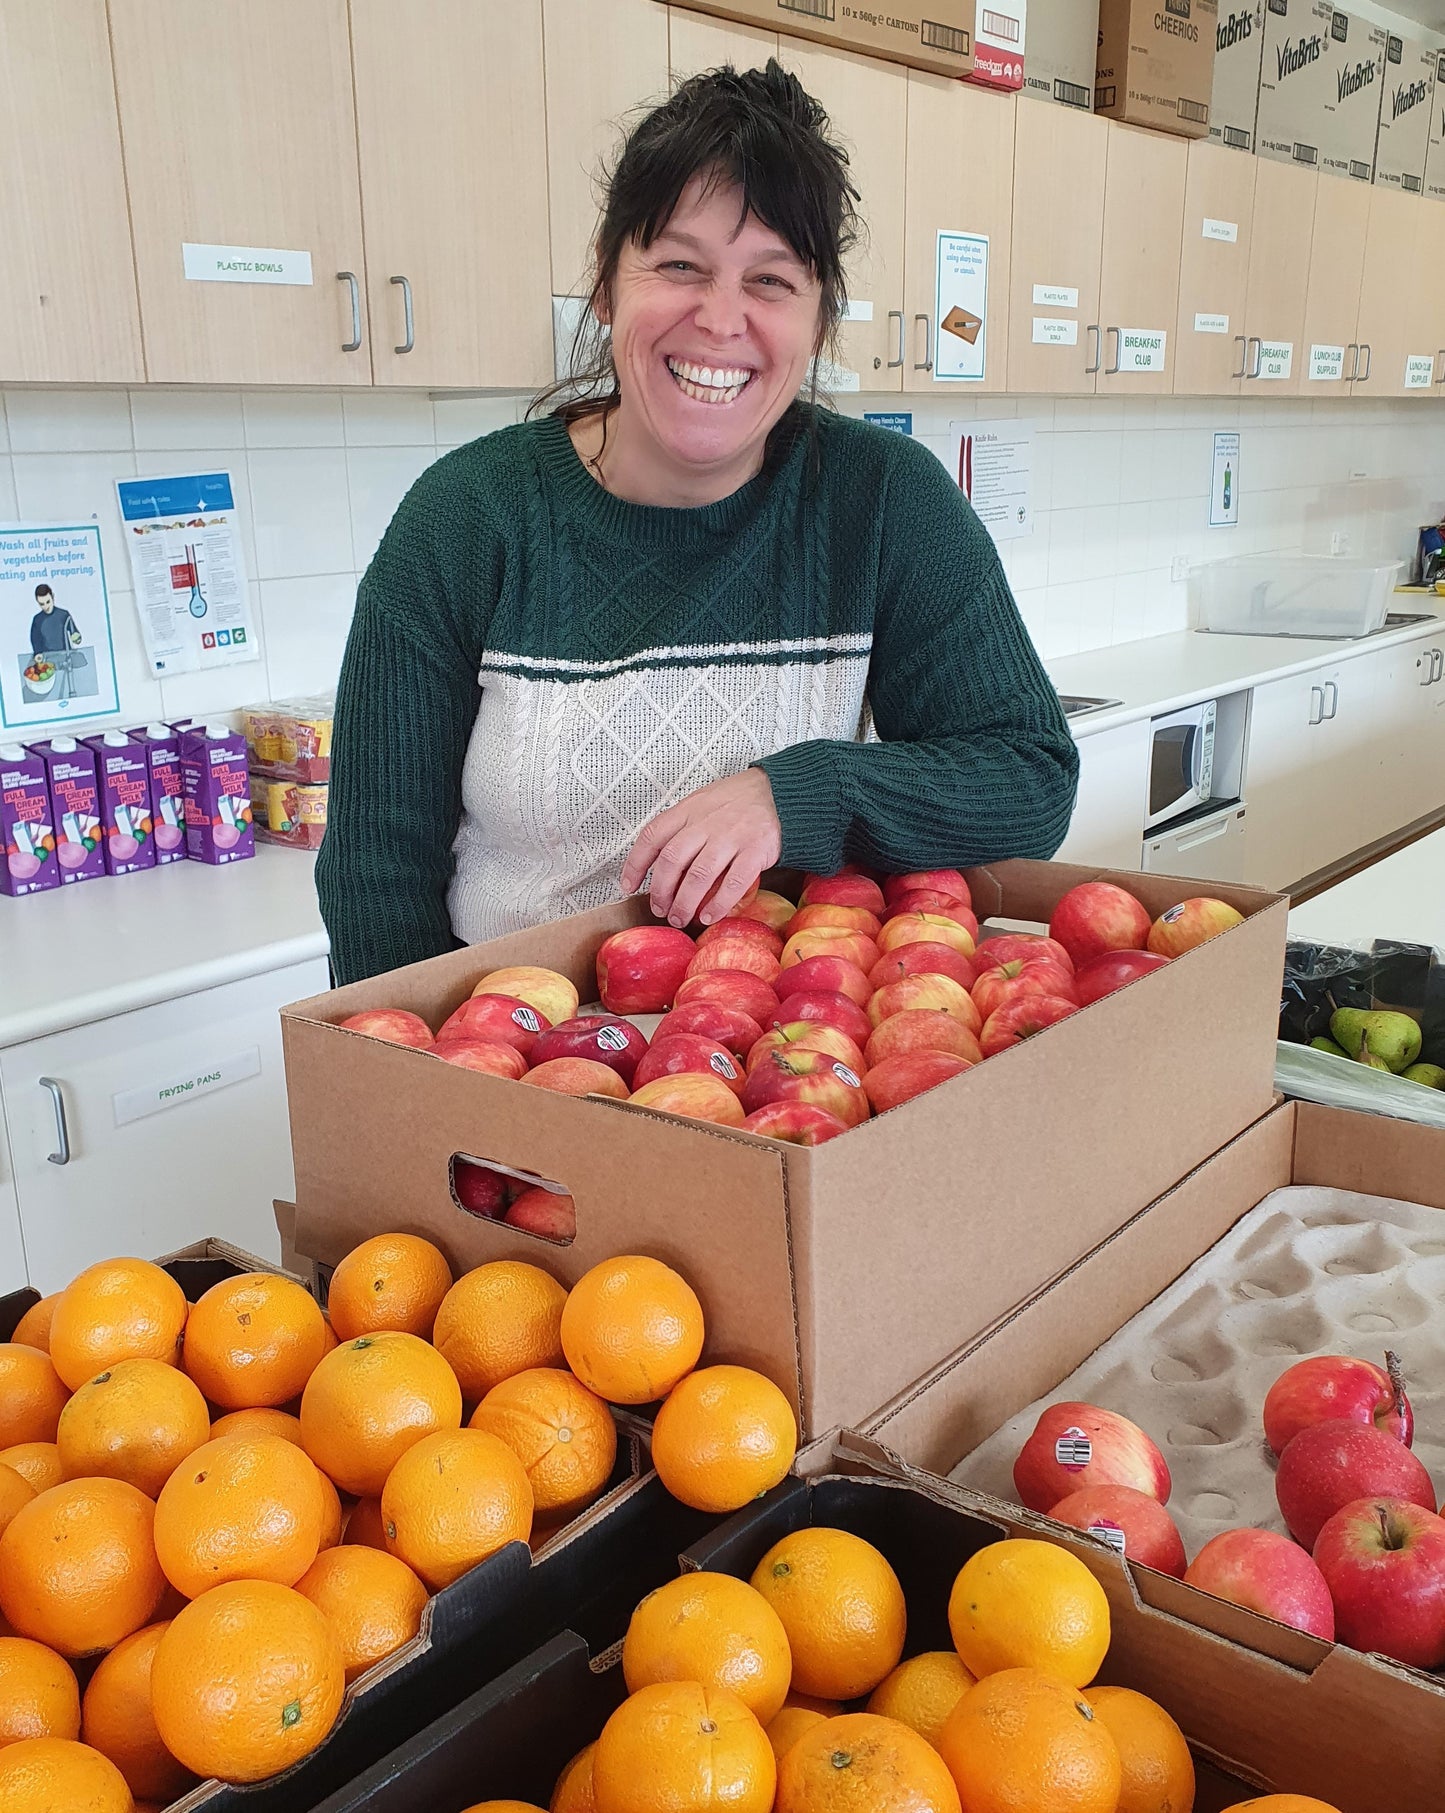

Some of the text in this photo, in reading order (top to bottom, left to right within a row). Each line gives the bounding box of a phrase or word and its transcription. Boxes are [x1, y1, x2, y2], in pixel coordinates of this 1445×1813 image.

[842, 6, 850, 17] 10
[852, 11, 858, 19] x
[886, 17, 919, 33] CARTONS
[1154, 13, 1199, 43] CHEERIOS
[1216, 11, 1252, 52] taBrits
[974, 55, 1003, 72] freedom
[1276, 35, 1321, 81] VitaBrits
[1028, 77, 1050, 92] CARTONS
[1336, 59, 1375, 103] VitaBrits
[1391, 80, 1427, 120] VitaBrits
[217, 261, 283, 272] PLASTIC BOWLS
[1125, 336, 1161, 349] BREAKFAST
[1261, 348, 1289, 359] BREAKFAST
[1314, 350, 1341, 361] LUNCH CLUB
[1135, 354, 1151, 365] CLUB
[1268, 363, 1281, 373] CLUB
[1317, 365, 1337, 375] SUPPLIES
[1410, 361, 1422, 370] LUNCH
[28, 539, 41, 549] all
[43, 538, 69, 551] fruits
[71, 536, 88, 546] and
[3, 551, 85, 567] vegetables before
[0, 565, 96, 581] ating and preparing.
[154, 767, 170, 778] FULL
[212, 767, 228, 776] FULL
[109, 776, 126, 787] FULL
[163, 775, 181, 785] CREA
[221, 773, 246, 784] CREAM
[56, 784, 74, 794] FULL
[119, 782, 145, 793] CREAM
[166, 784, 181, 795] MIL
[224, 784, 242, 794] MILK
[6, 792, 24, 803] FULL
[66, 789, 93, 801] CREAM
[121, 793, 140, 804] MILK
[16, 798, 45, 810] CREAM
[70, 801, 89, 812] MILK
[20, 810, 41, 821] MILK
[159, 1070, 222, 1100] FRYING PANS
